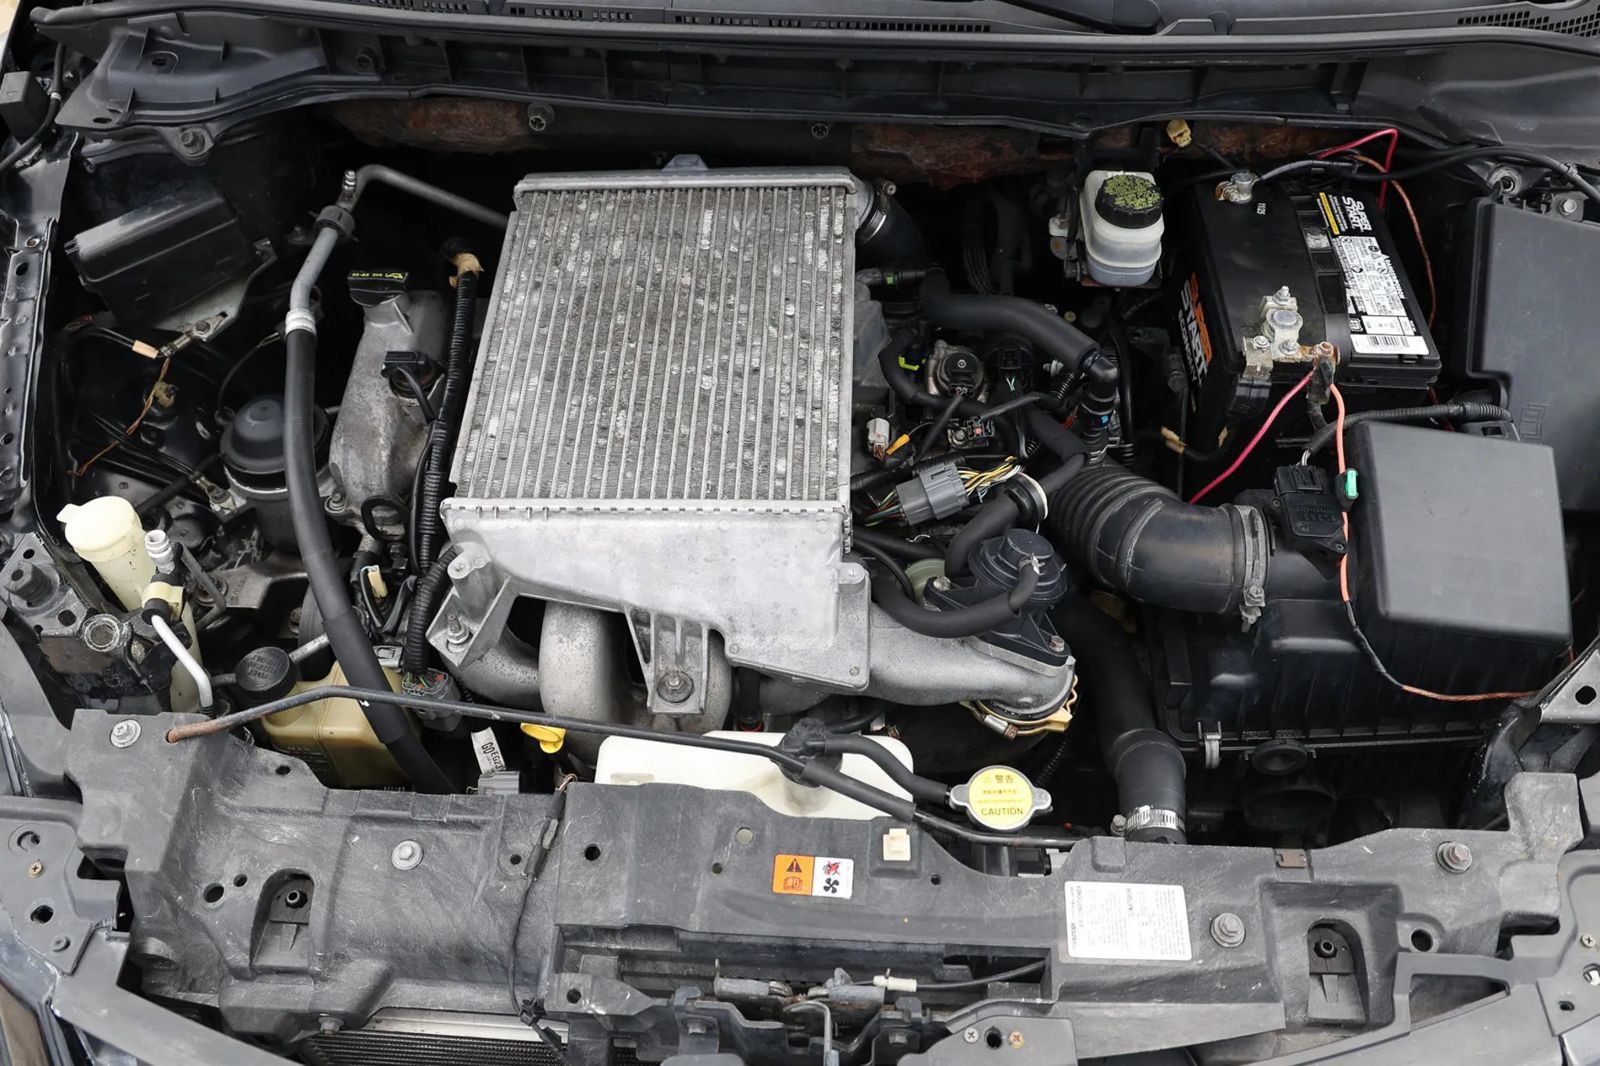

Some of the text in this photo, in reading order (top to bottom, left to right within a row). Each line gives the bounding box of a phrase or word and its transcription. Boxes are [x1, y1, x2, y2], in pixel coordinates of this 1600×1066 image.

[1341, 196, 1363, 233] START
[1352, 200, 1373, 232] SUPER
[1178, 309, 1198, 382] ECONOMY
[1180, 279, 1208, 387] START
[981, 807, 1024, 816] CAUTION
